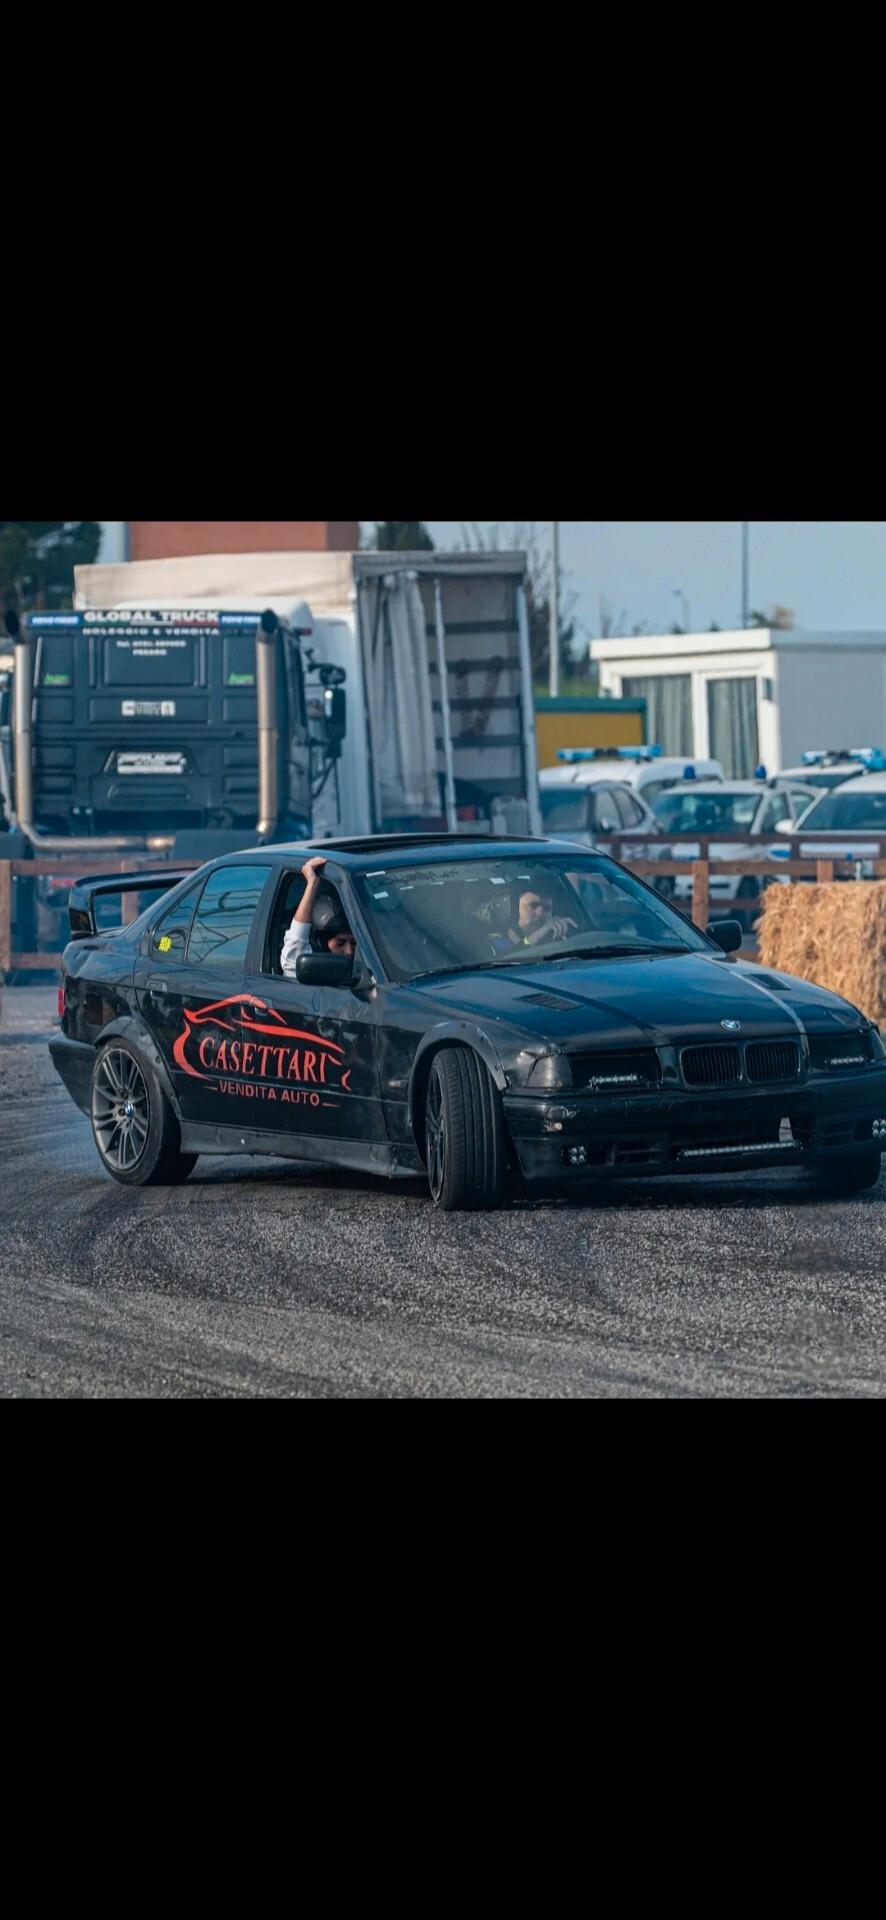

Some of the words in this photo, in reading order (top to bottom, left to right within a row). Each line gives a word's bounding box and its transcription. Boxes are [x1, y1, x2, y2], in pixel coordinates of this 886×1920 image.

[83, 610, 156, 622] GLOBAL
[159, 610, 219, 622] TRUCK
[82, 627, 149, 636] NOLEGGIO
[152, 627, 161, 636] E
[165, 627, 220, 636] VENDITA
[198, 1036, 327, 1083] CASETTARI
[219, 1080, 277, 1101] VENDITA
[281, 1089, 320, 1107] AUTO
